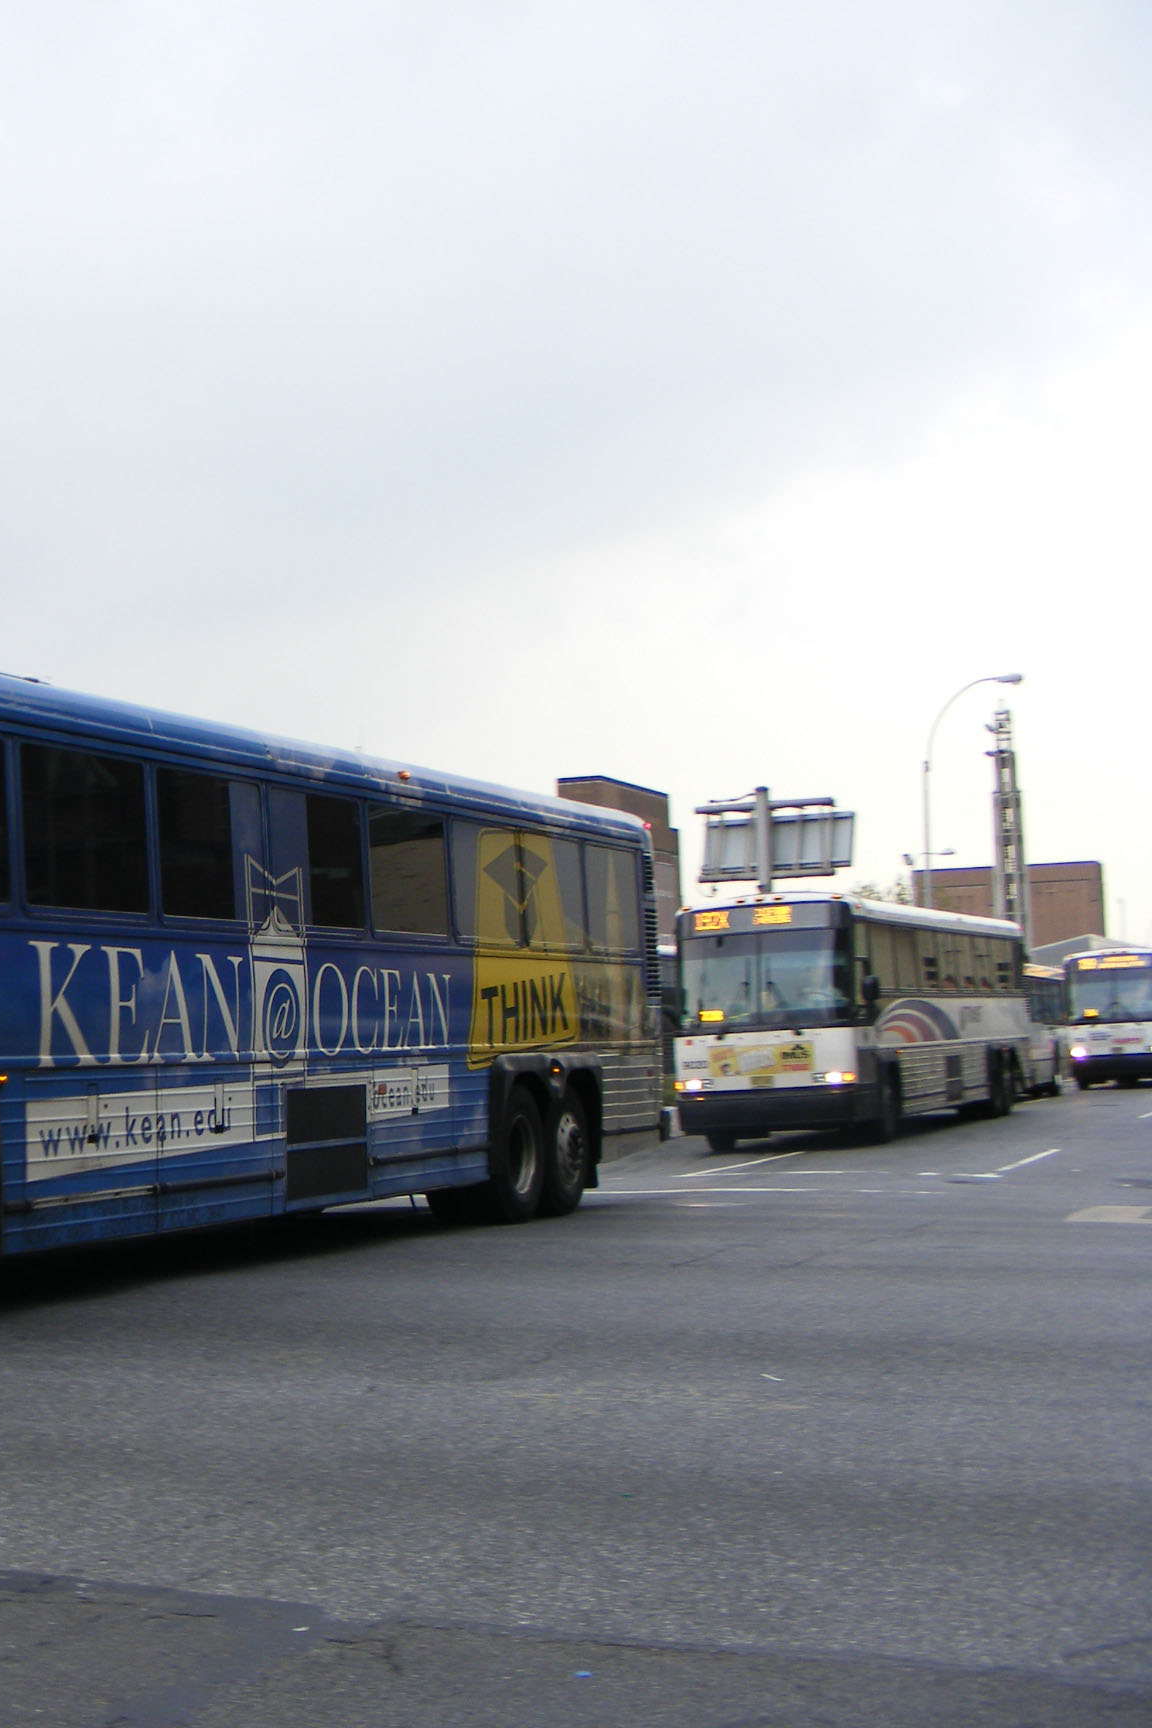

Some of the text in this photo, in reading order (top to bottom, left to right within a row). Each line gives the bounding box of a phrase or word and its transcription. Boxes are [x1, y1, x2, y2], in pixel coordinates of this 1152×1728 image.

[28, 940, 244, 1068] KEAN
[312, 962, 451, 1057] OCEAN
[481, 973, 569, 1049] THINK
[38, 1096, 232, 1158] www.kean.edu
